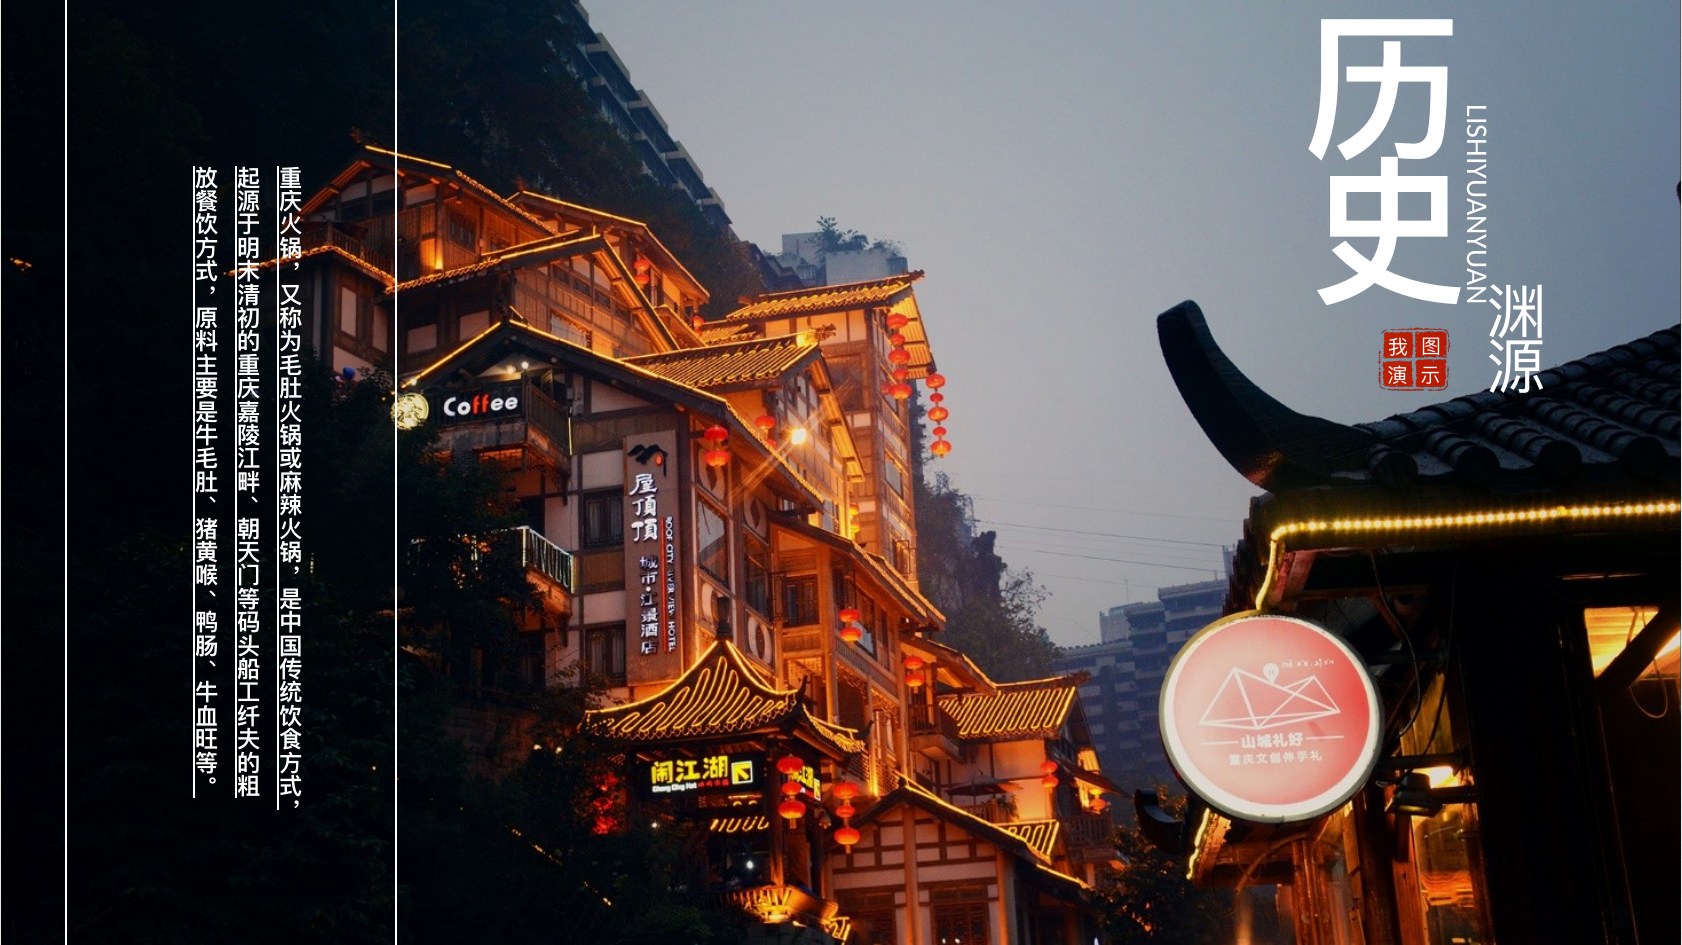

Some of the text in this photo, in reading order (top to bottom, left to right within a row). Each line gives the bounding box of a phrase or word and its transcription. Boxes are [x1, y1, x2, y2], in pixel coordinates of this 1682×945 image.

[443, 394, 518, 417] Coffee
[665, 516, 673, 541] ROOF
[666, 543, 674, 564] CITY
[668, 621, 677, 652] HOTEL
[651, 755, 728, 784] 闹江湖
